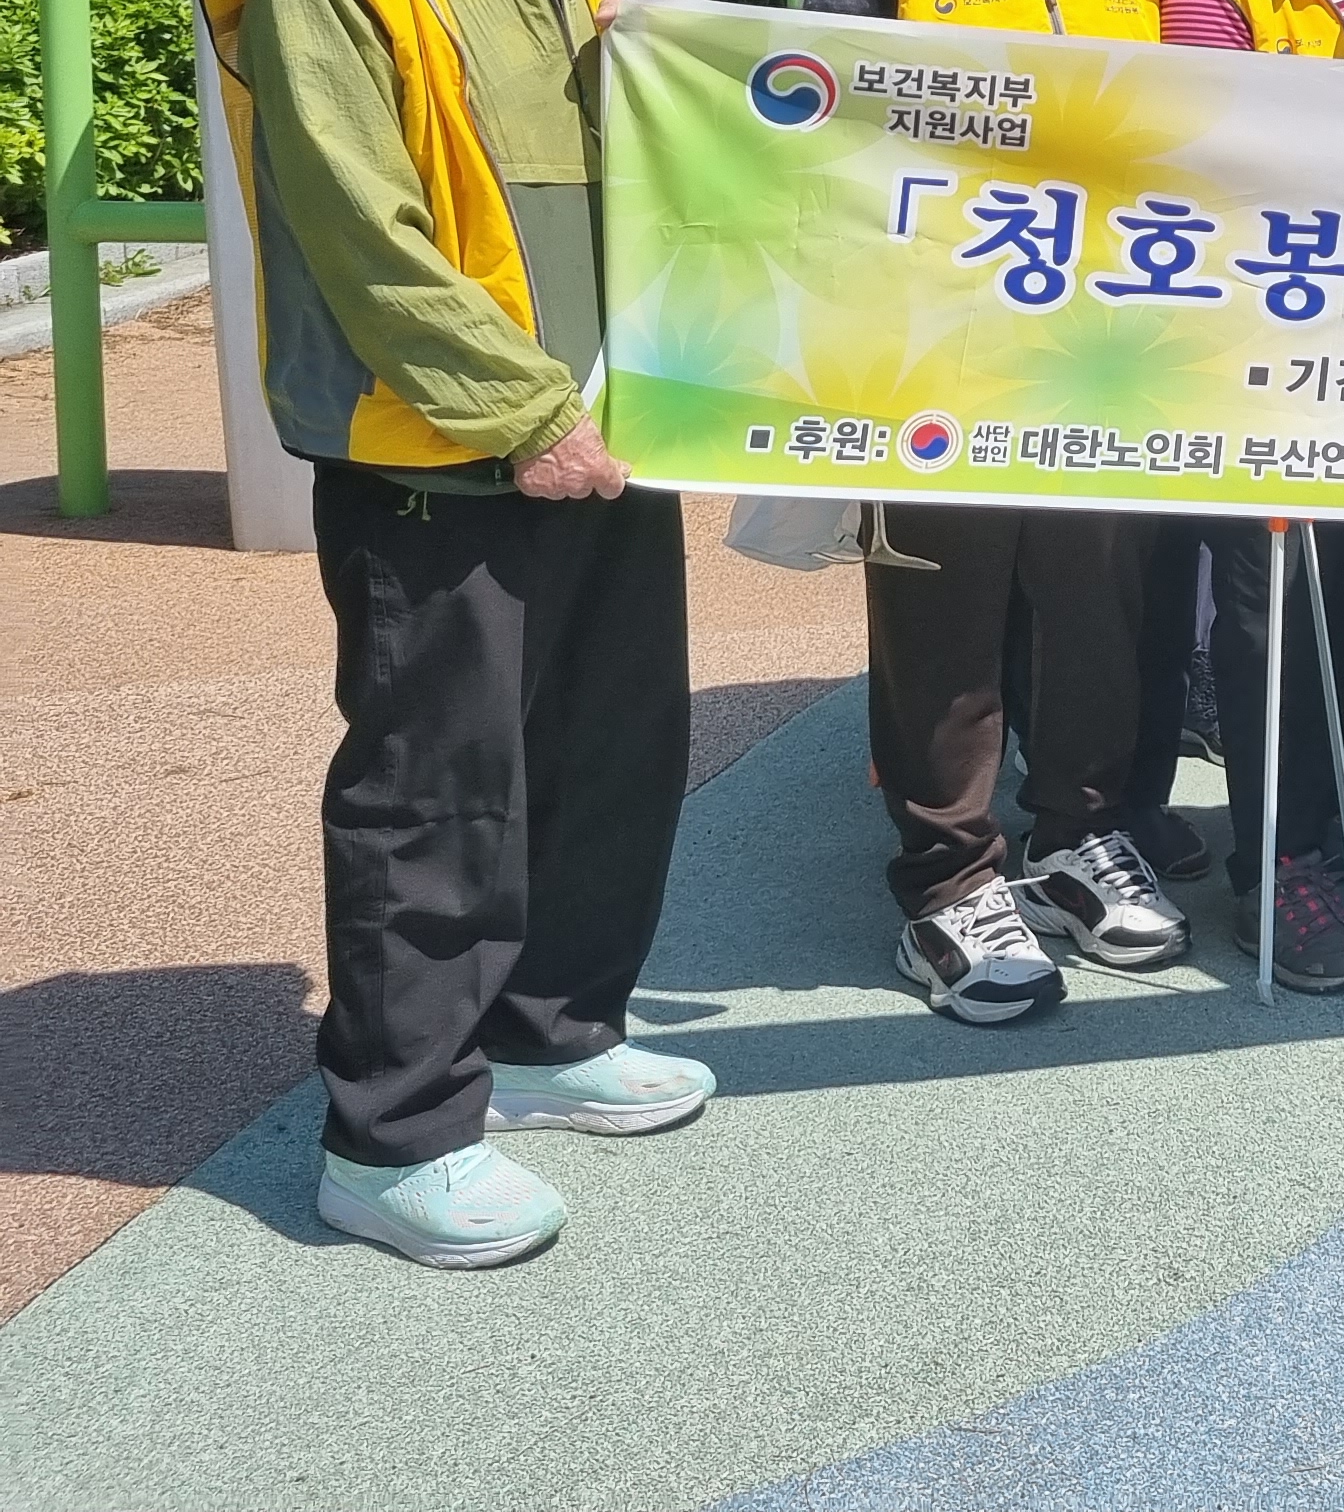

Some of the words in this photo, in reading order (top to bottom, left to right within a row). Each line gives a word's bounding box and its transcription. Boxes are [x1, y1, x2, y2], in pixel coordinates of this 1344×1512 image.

[853, 64, 1033, 108] 보건복지부
[888, 108, 1028, 148] 지원사업
[788, 419, 889, 461] 후원:
[971, 444, 1008, 464] 법인
[973, 424, 1011, 443] 사단
[1020, 426, 1224, 475] 대한노인회
